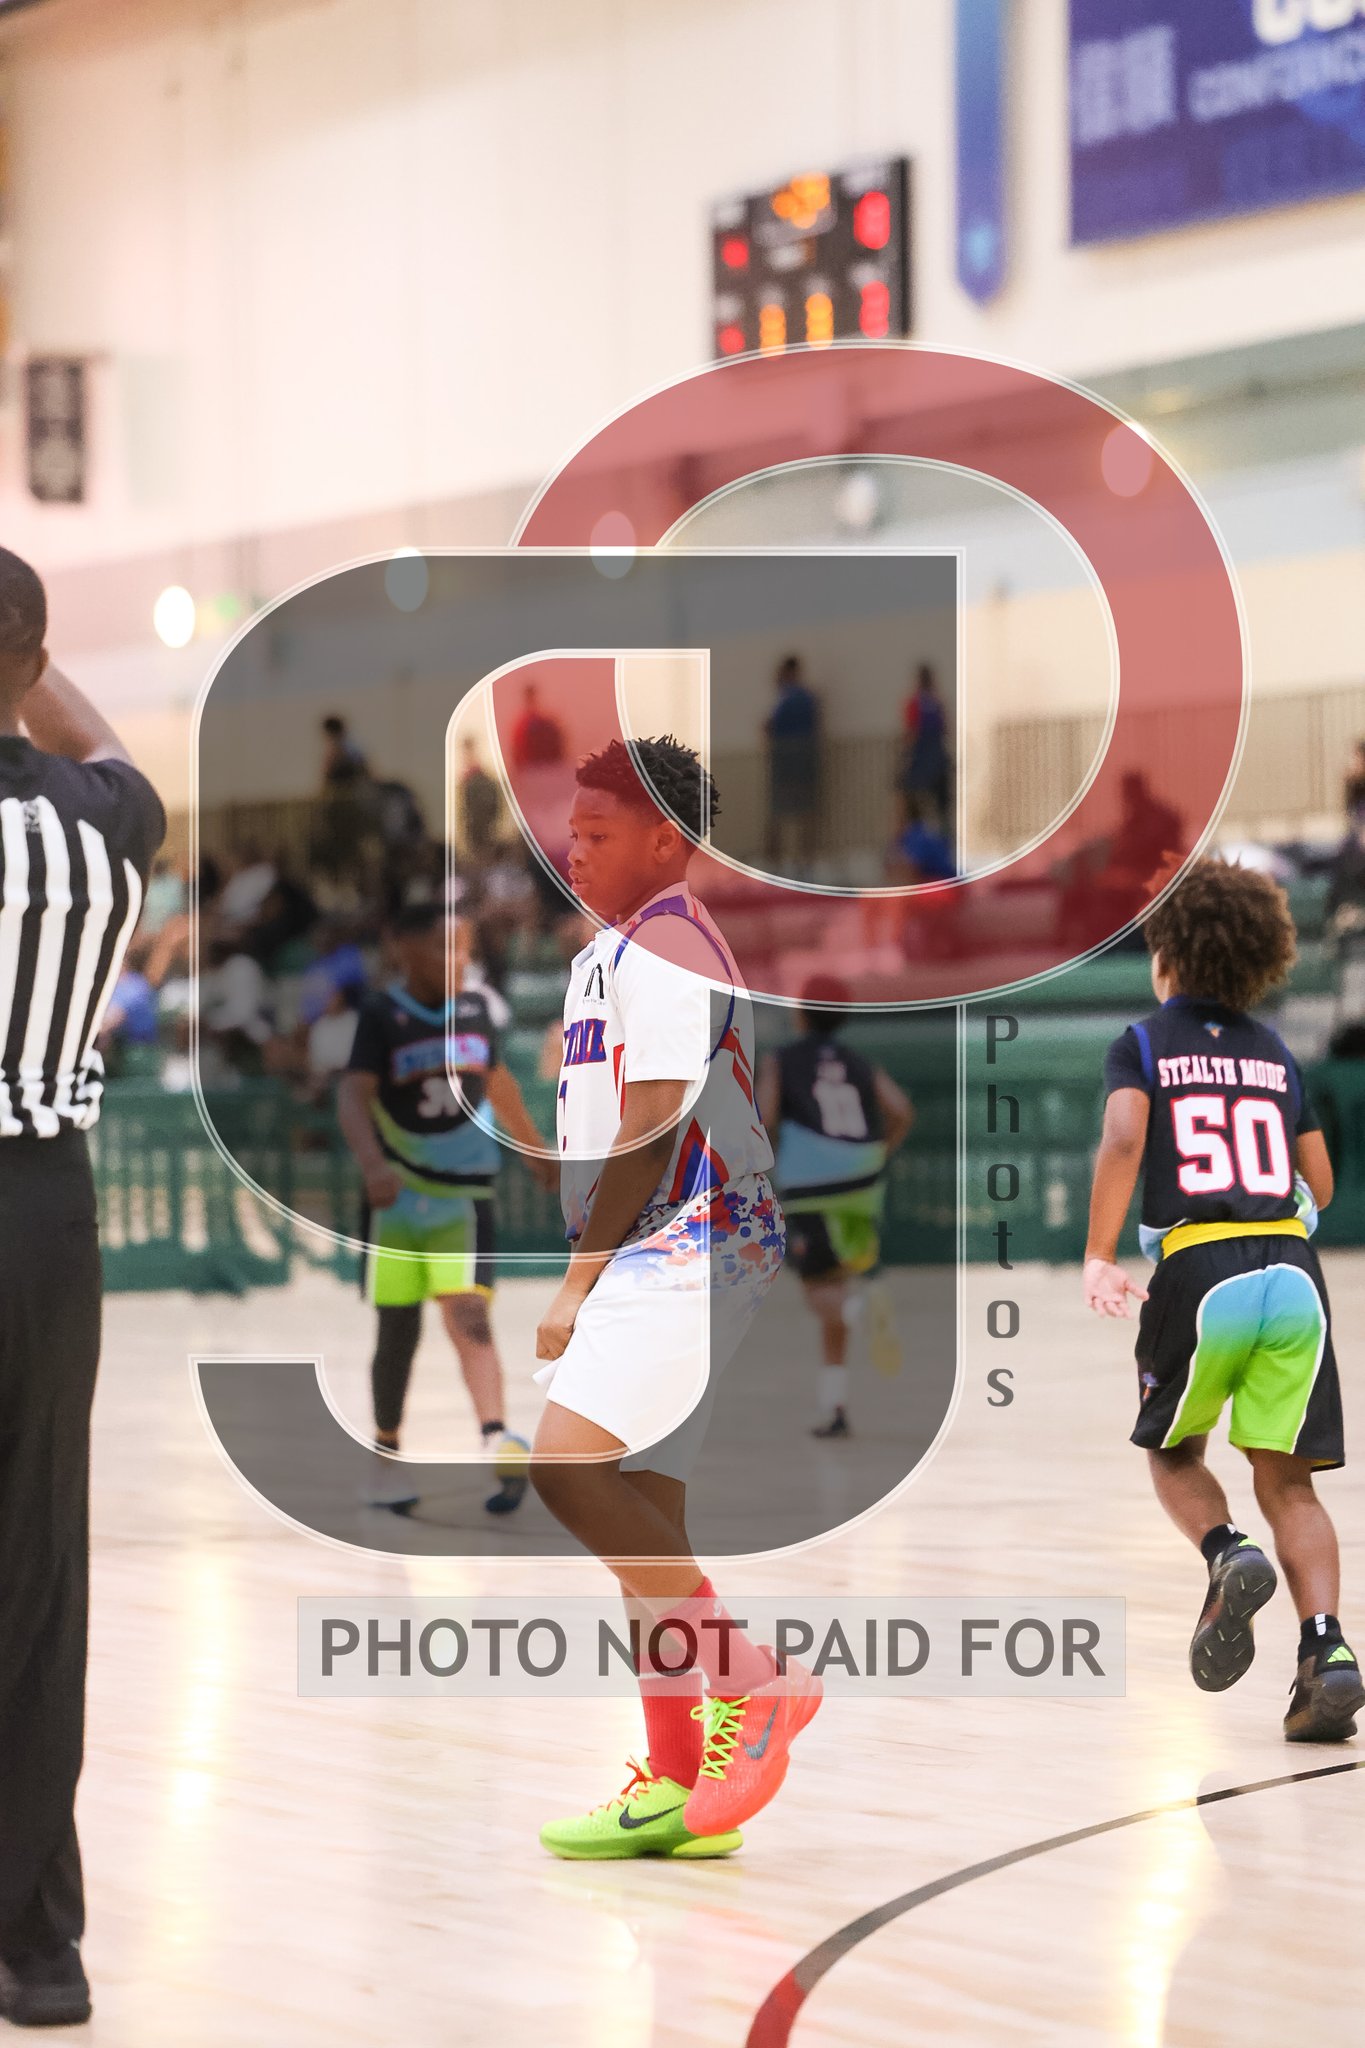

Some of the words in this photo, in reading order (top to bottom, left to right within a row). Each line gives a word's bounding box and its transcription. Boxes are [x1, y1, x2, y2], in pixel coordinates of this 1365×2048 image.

[1158, 1055, 1237, 1088] STEALTH
[1239, 1058, 1288, 1093] MODE
[1170, 1094, 1291, 1198] 50
